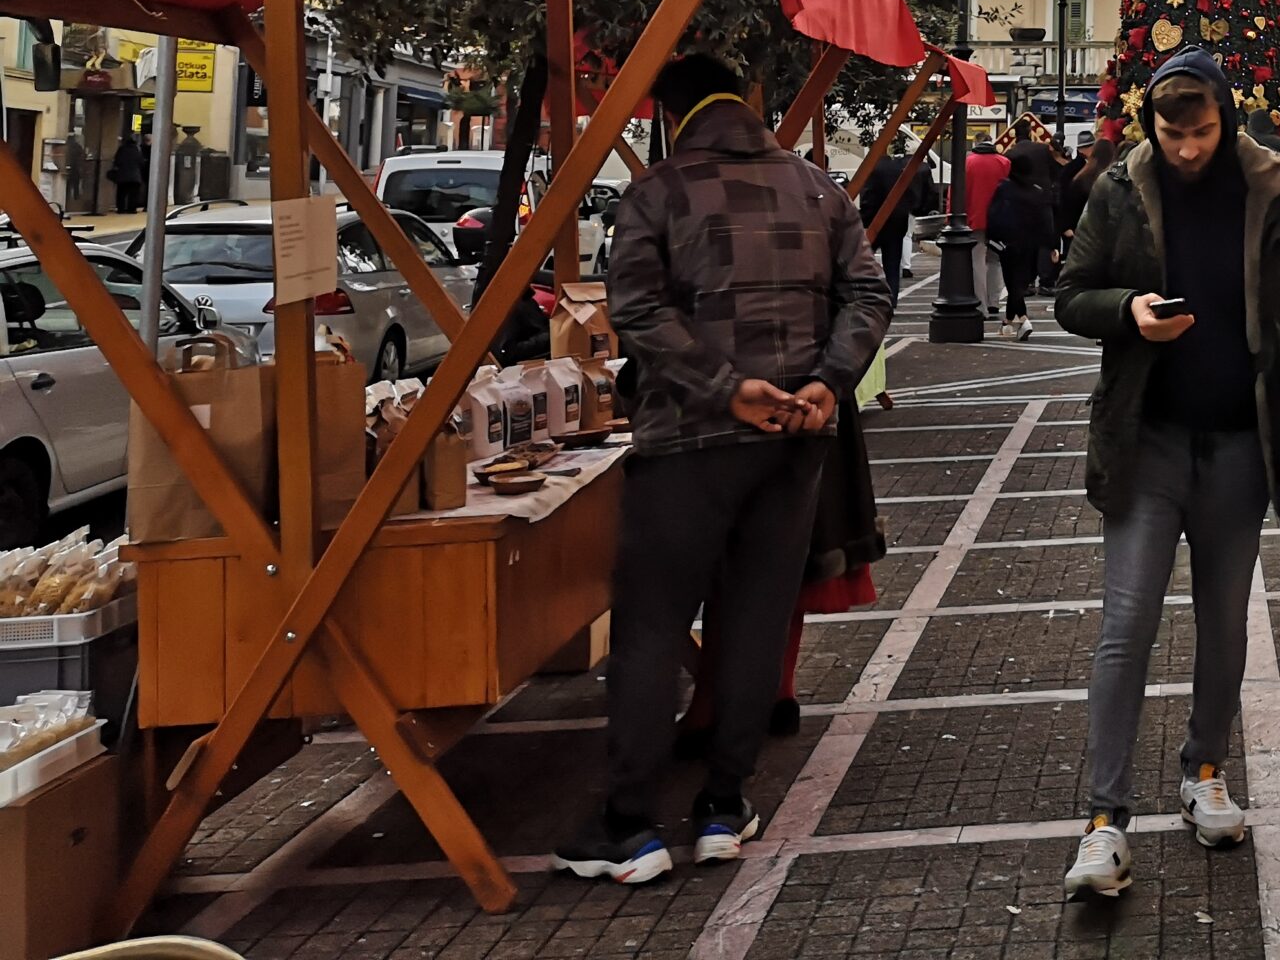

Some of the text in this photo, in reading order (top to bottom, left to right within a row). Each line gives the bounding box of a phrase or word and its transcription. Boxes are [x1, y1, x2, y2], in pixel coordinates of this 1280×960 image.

[178, 61, 207, 71] Otkup
[177, 70, 208, 80] Zlata
[969, 105, 985, 117] RY
